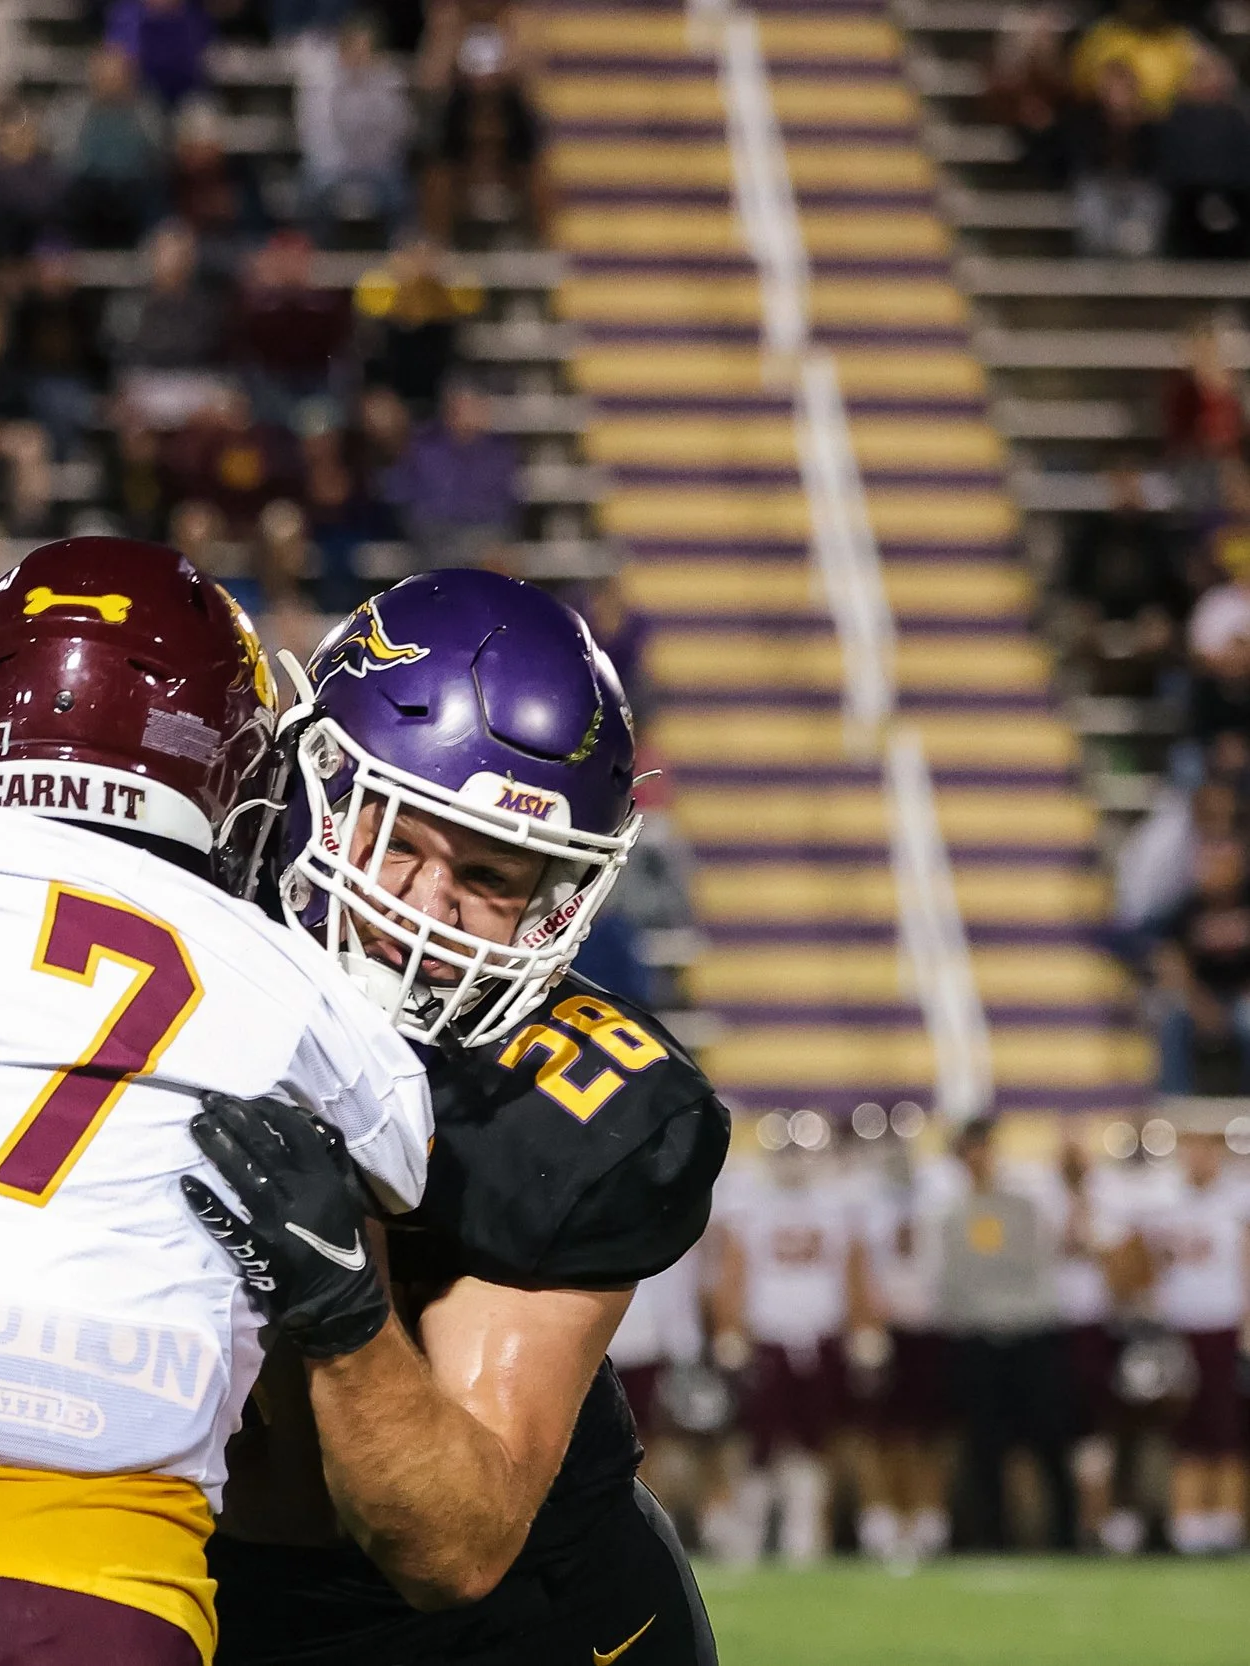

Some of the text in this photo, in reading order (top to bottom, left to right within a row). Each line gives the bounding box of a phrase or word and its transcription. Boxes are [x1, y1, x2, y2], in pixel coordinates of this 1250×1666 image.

[101, 780, 146, 820] IT
[494, 785, 558, 822] MSU
[496, 994, 670, 1125] 28
